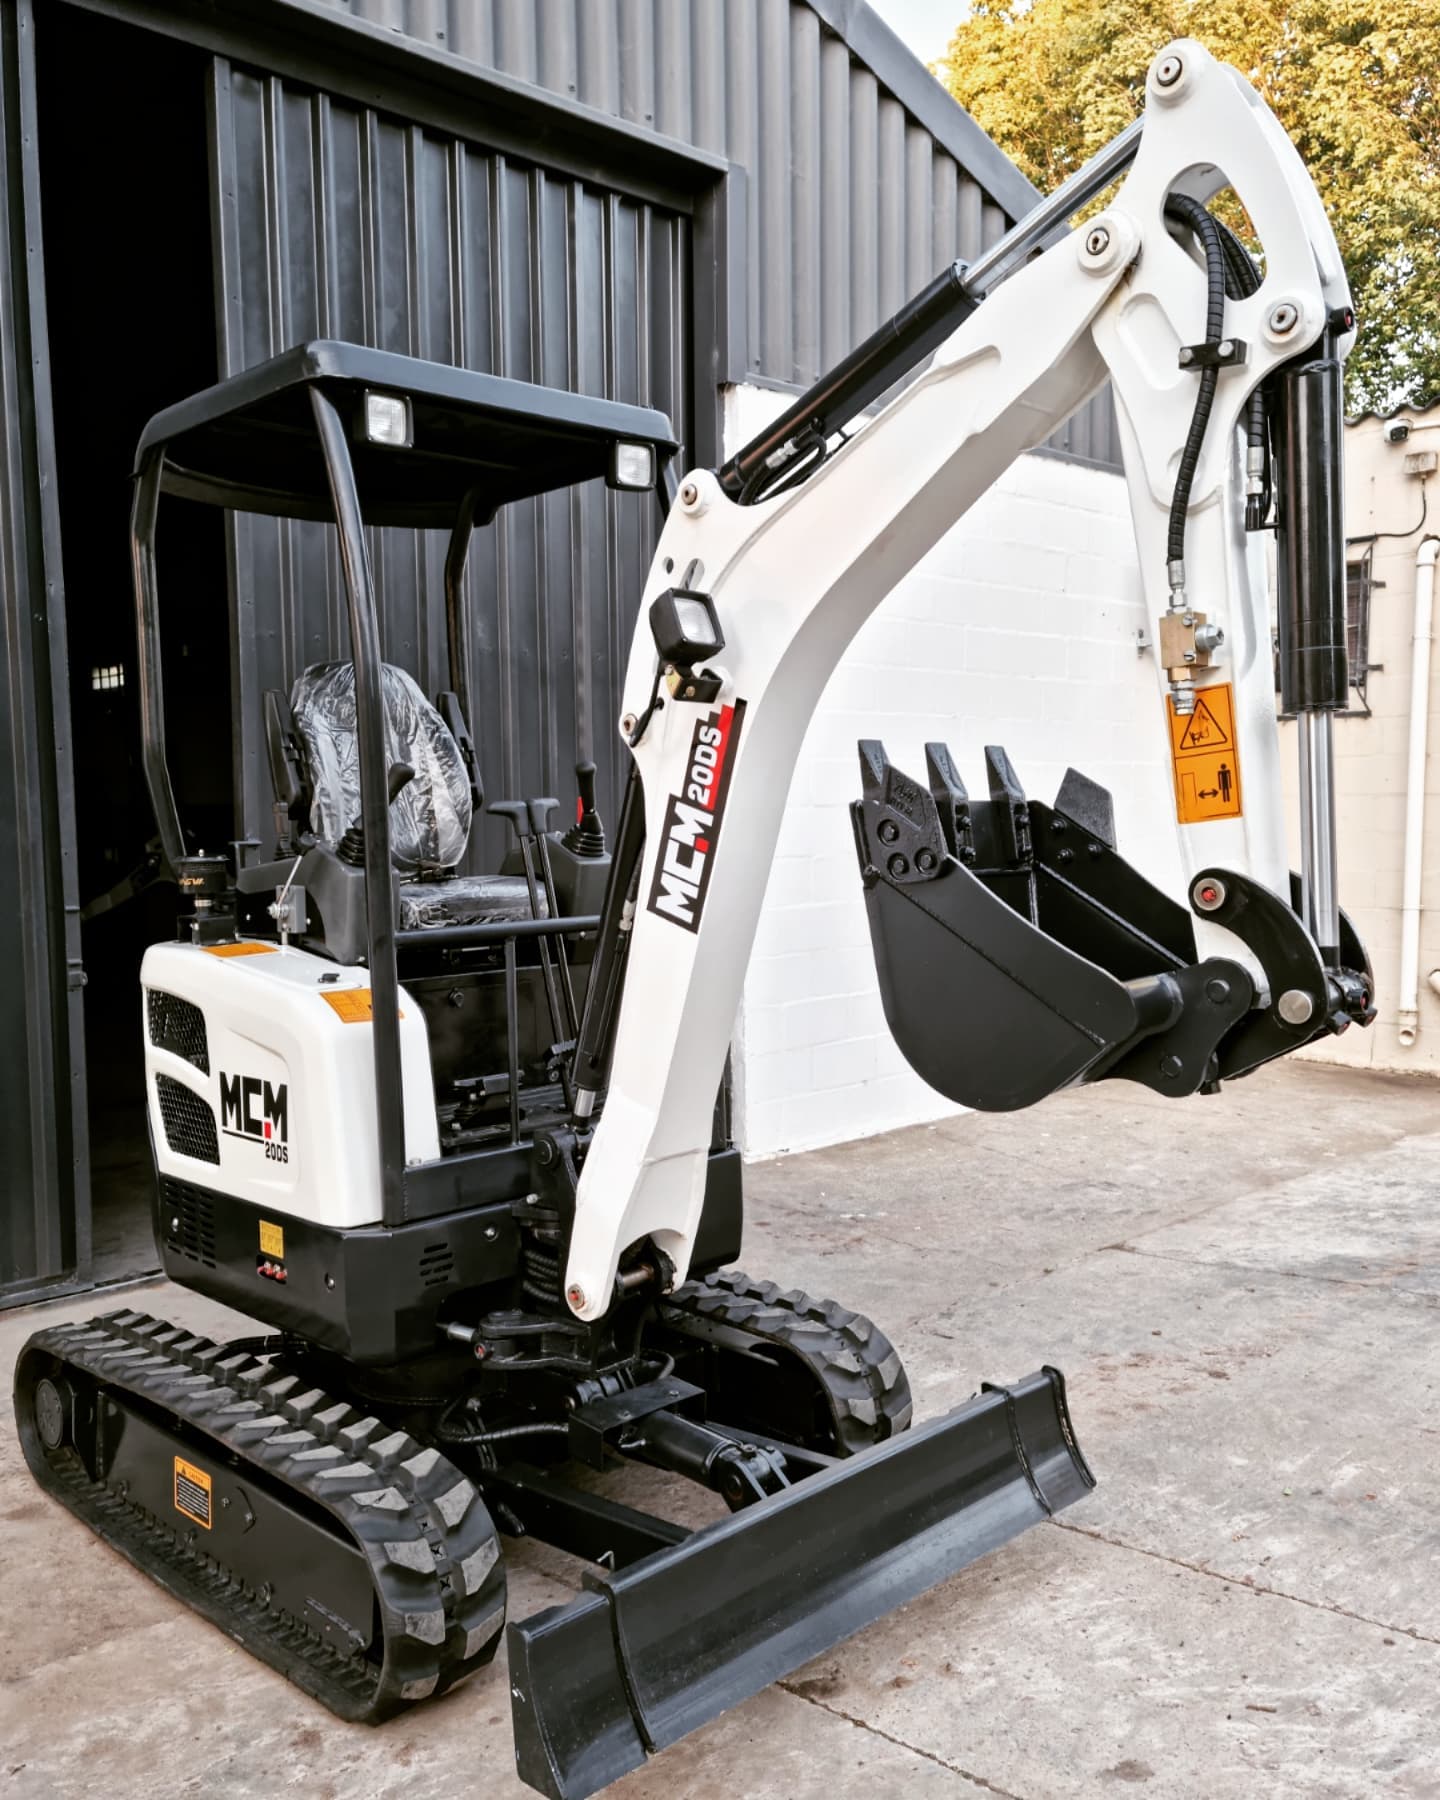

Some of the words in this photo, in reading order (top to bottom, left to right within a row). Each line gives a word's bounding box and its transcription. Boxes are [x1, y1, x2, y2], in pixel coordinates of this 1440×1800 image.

[655, 800, 714, 924] MCM
[688, 726, 723, 806] 20DS
[219, 1071, 288, 1143] MCM
[264, 1141, 289, 1164] 20DS
